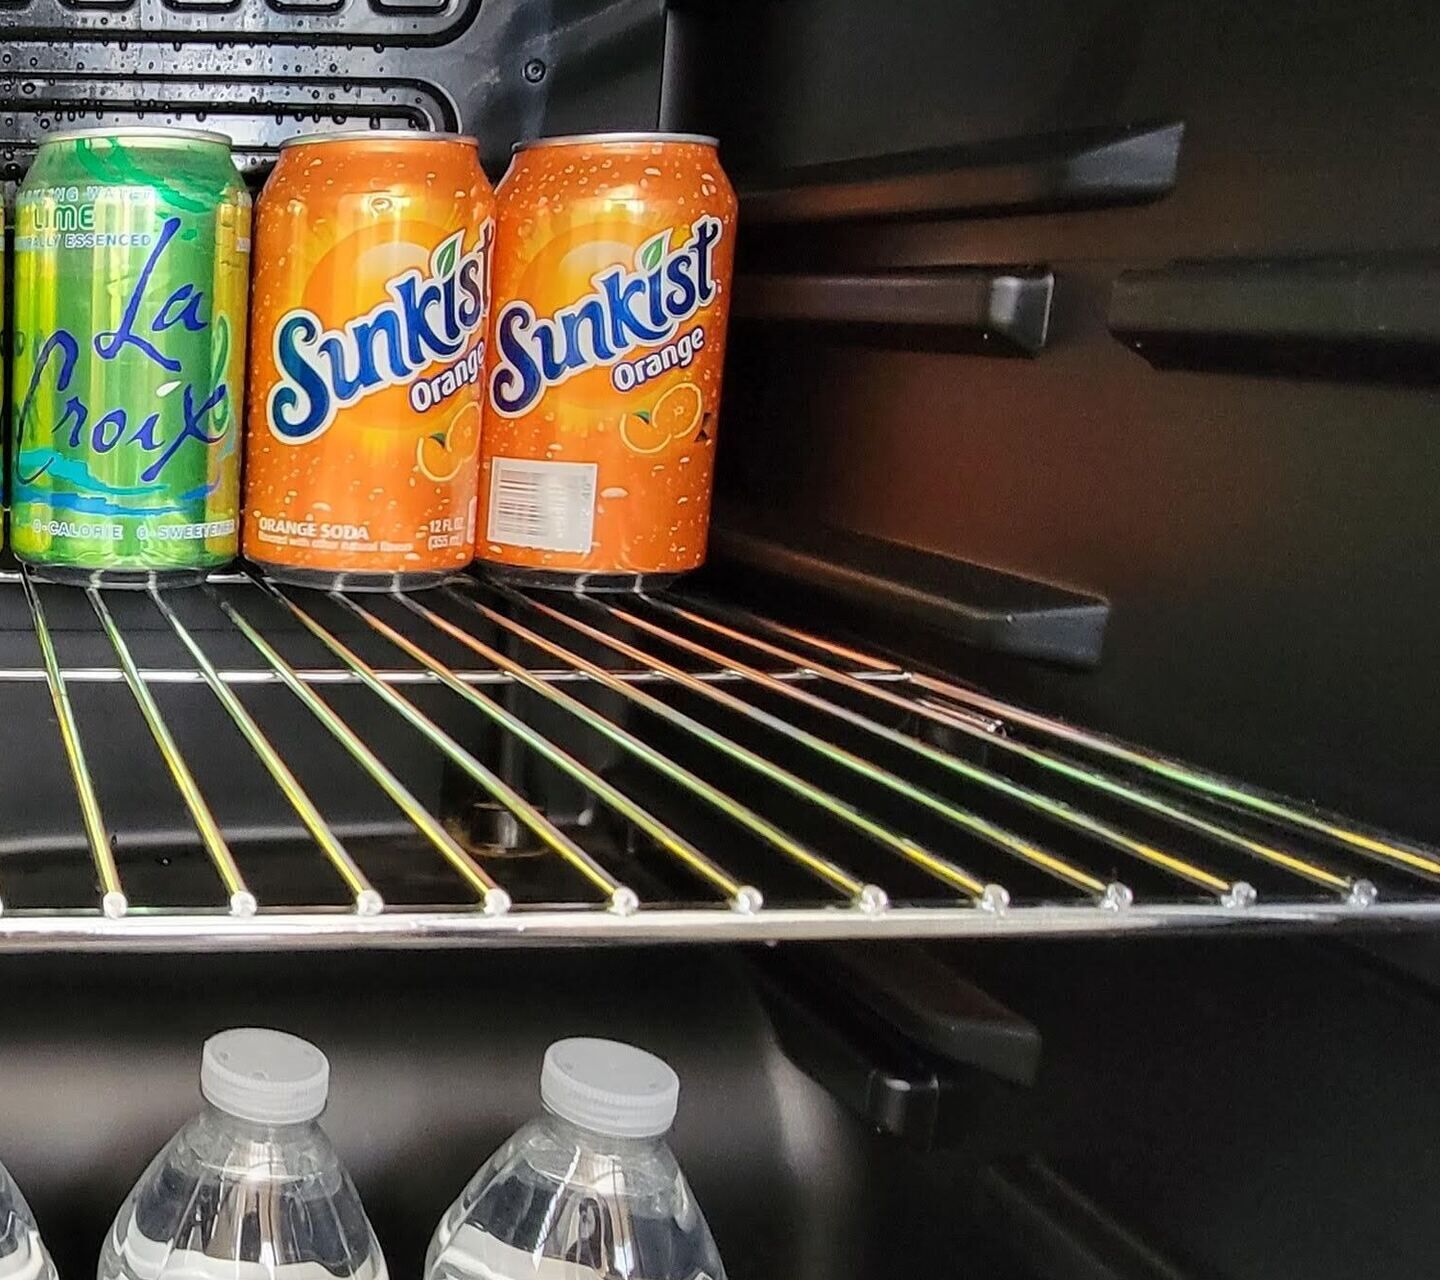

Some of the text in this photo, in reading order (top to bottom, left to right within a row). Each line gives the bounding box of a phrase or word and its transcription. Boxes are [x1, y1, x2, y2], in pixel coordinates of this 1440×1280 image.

[33, 204, 96, 231] LIME
[65, 234, 151, 249] ESSENCED
[94, 217, 209, 372] La
[490, 215, 722, 417] Sunkist
[612, 327, 705, 391] Orange
[15, 329, 228, 485] Croix
[259, 517, 369, 540] ORANGE SODA
[430, 519, 441, 533] 12
